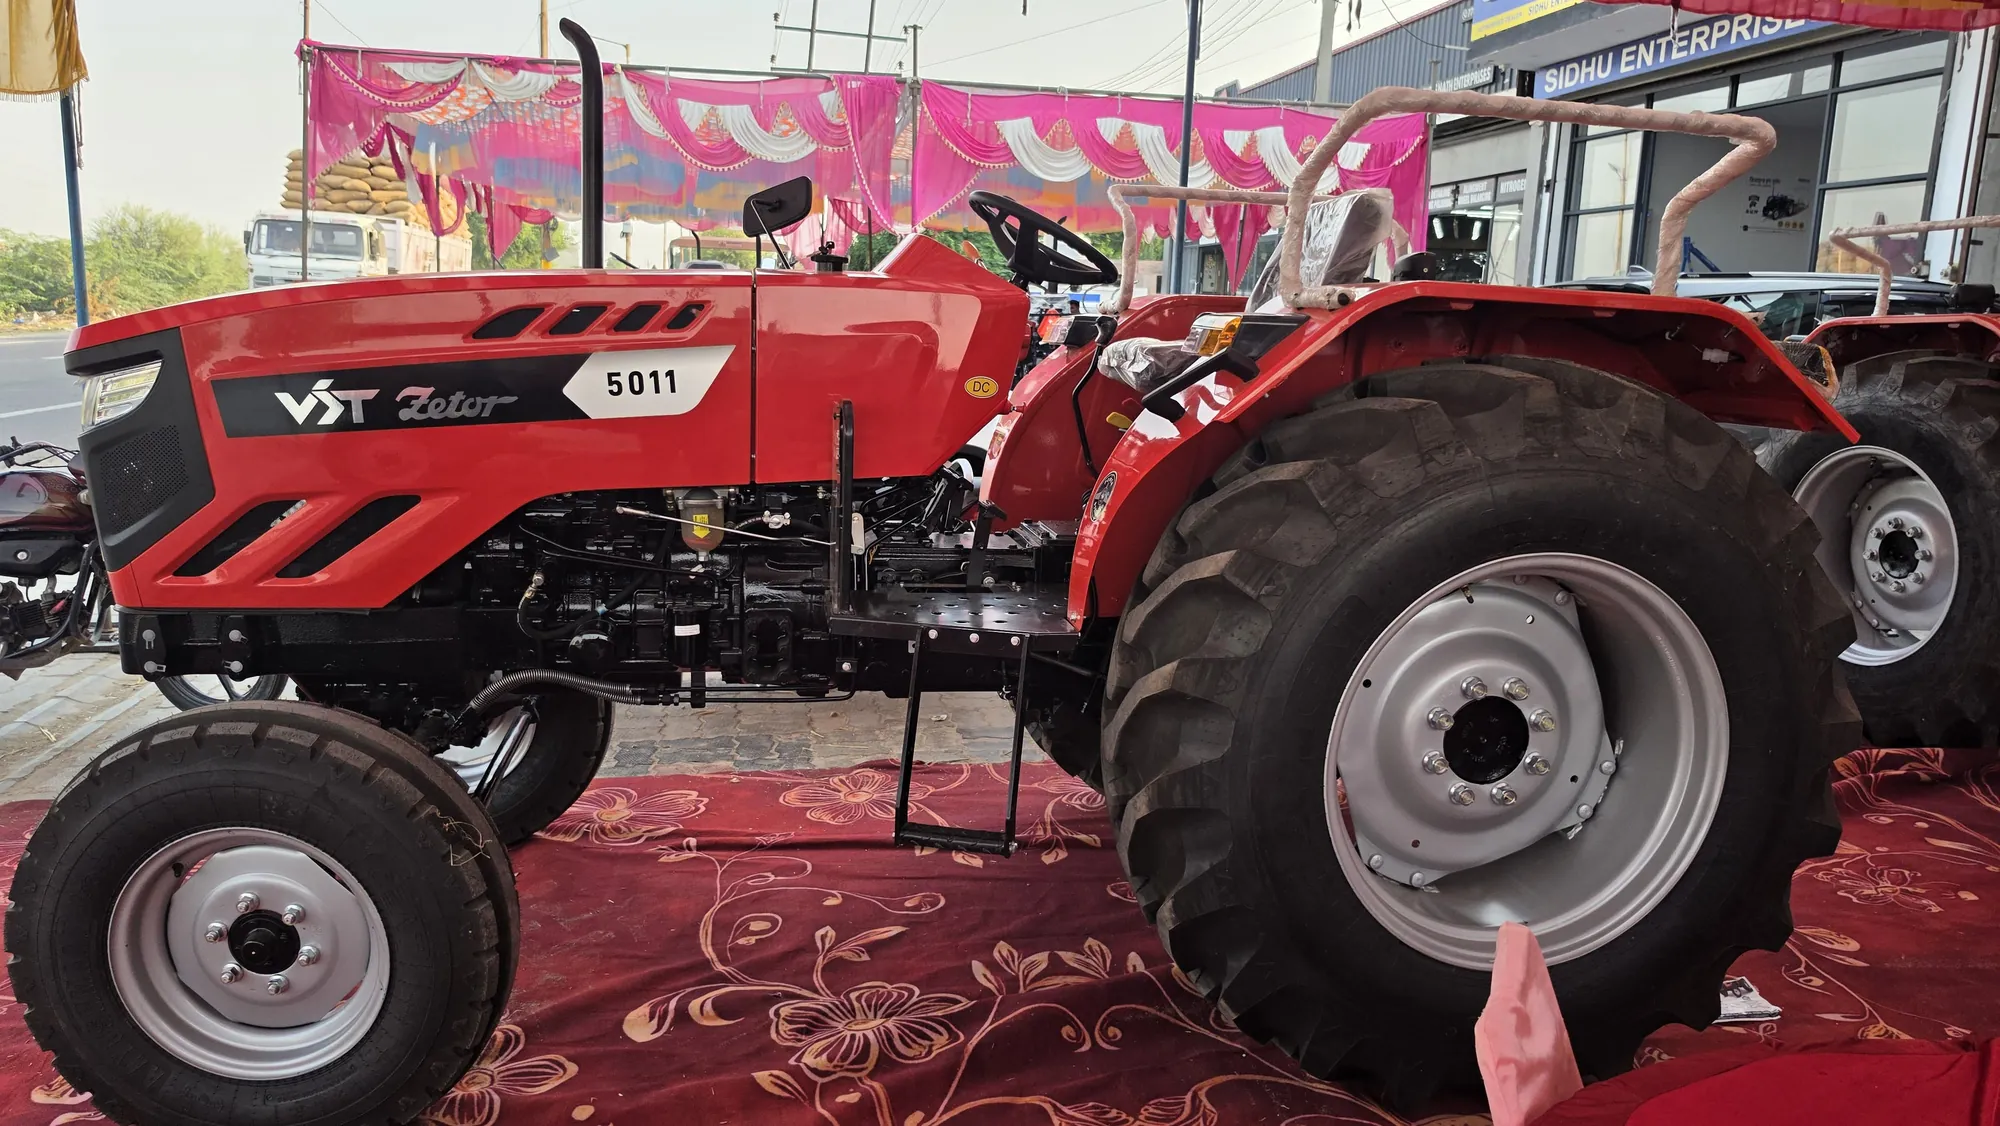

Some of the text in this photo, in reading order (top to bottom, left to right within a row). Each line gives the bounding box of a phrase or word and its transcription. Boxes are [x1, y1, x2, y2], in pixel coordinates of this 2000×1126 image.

[1528, 1, 1548, 16] SIDHU
[1453, 67, 1492, 91] ENTERPRISES
[1544, 51, 1613, 93] SIDHU
[1500, 178, 1527, 194] NITROGE
[606, 369, 679, 397] 5011
[973, 381, 990, 393] DC
[395, 386, 519, 421] Zetor
